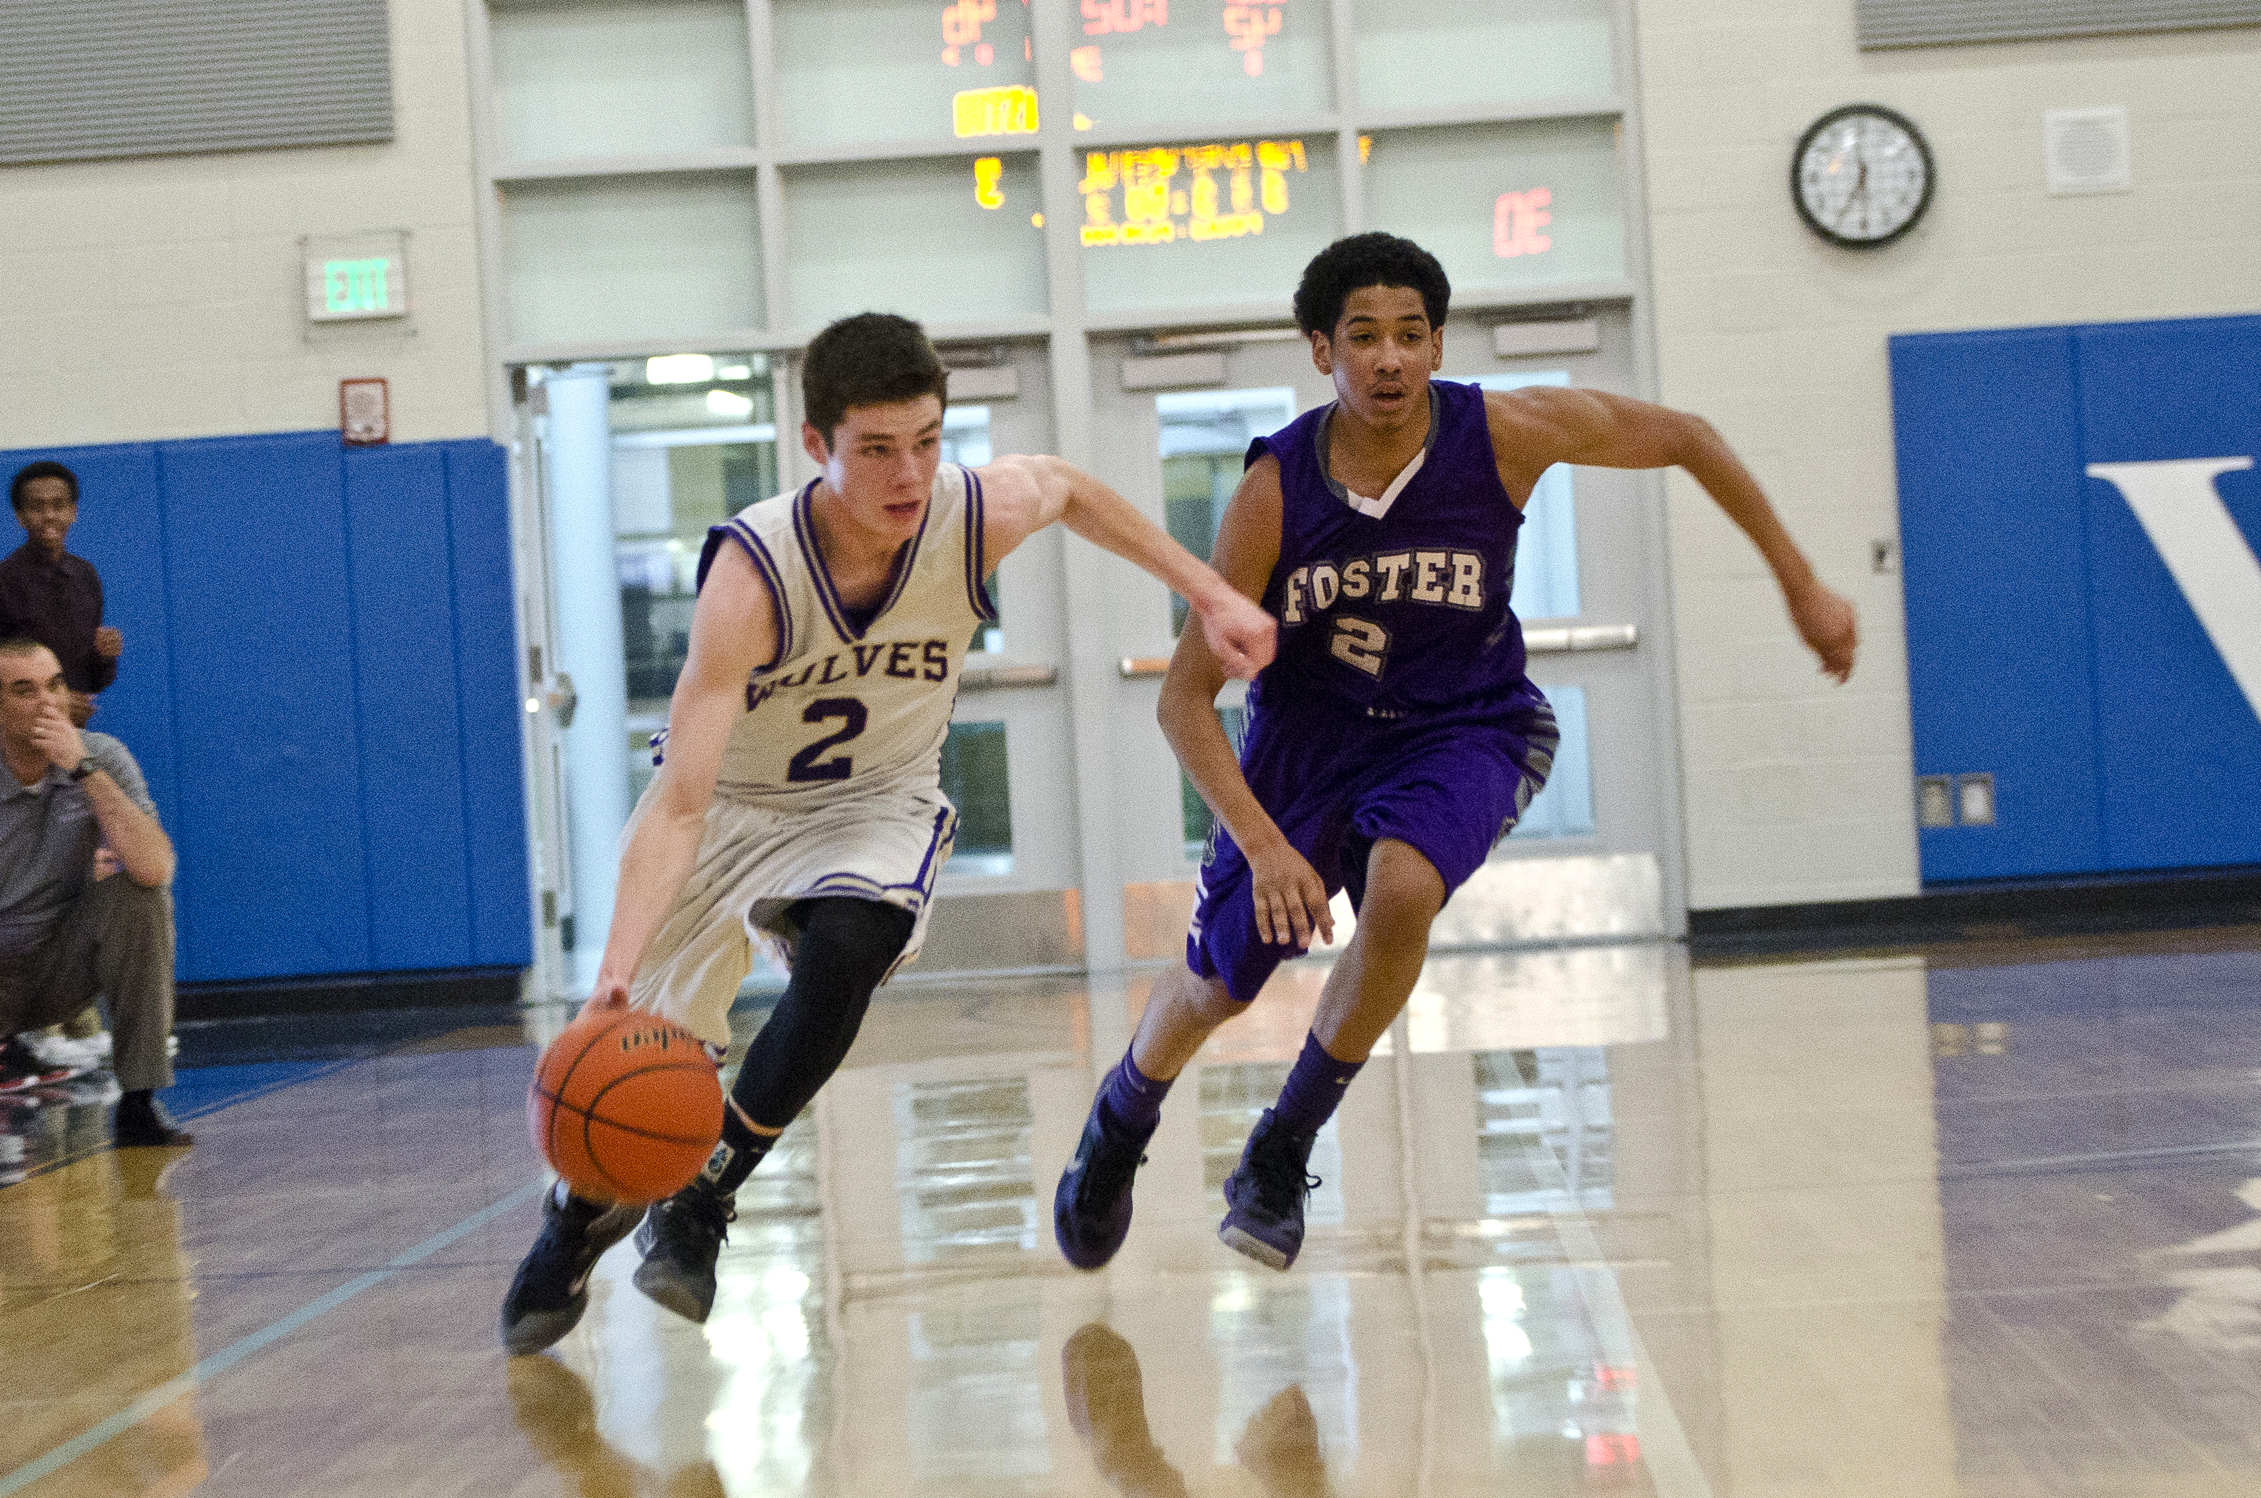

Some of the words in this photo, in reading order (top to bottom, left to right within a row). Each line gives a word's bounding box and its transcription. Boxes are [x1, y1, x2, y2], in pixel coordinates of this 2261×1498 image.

[325, 257, 389, 312] EXIT
[1281, 549, 1486, 625] FOSTER
[1329, 614, 1391, 680] 2
[787, 697, 868, 782] 2
